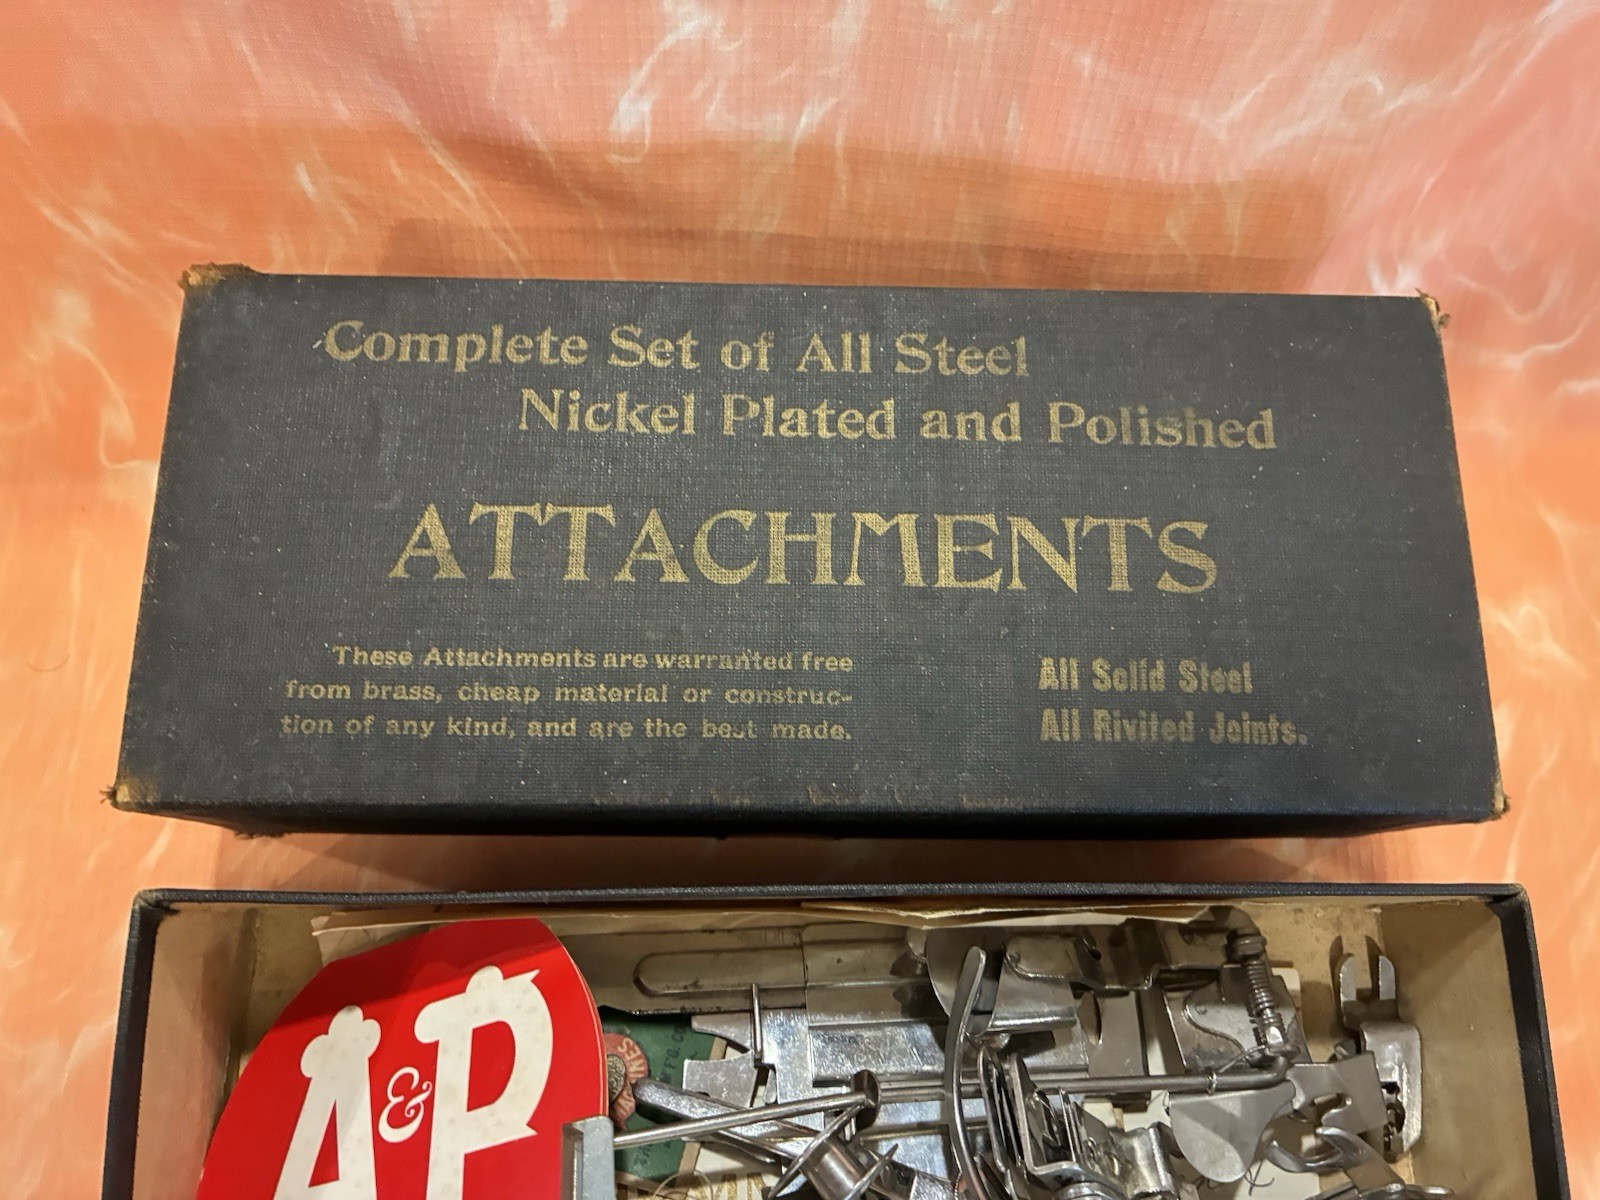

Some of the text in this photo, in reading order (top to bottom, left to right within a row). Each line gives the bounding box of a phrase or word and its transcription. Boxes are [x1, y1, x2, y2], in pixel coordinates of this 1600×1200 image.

[324, 320, 1029, 377] Complete Set of All Steel
[518, 388, 1278, 451] Nickel Plated and Polished
[388, 502, 1219, 594] ATTACHMENTS
[331, 645, 854, 673] These Attachments are warranted free
[1037, 657, 1254, 694] All Solid Steel
[284, 680, 853, 706] from brass, cheap material or construc-
[279, 715, 334, 735] tion
[345, 714, 375, 735] of
[385, 719, 436, 740] any
[447, 716, 515, 739] kind,
[527, 718, 577, 739] and
[588, 721, 634, 740] are
[643, 718, 688, 739] the
[770, 721, 852, 741] made.
[1040, 708, 1308, 746] All Rivited Joints.
